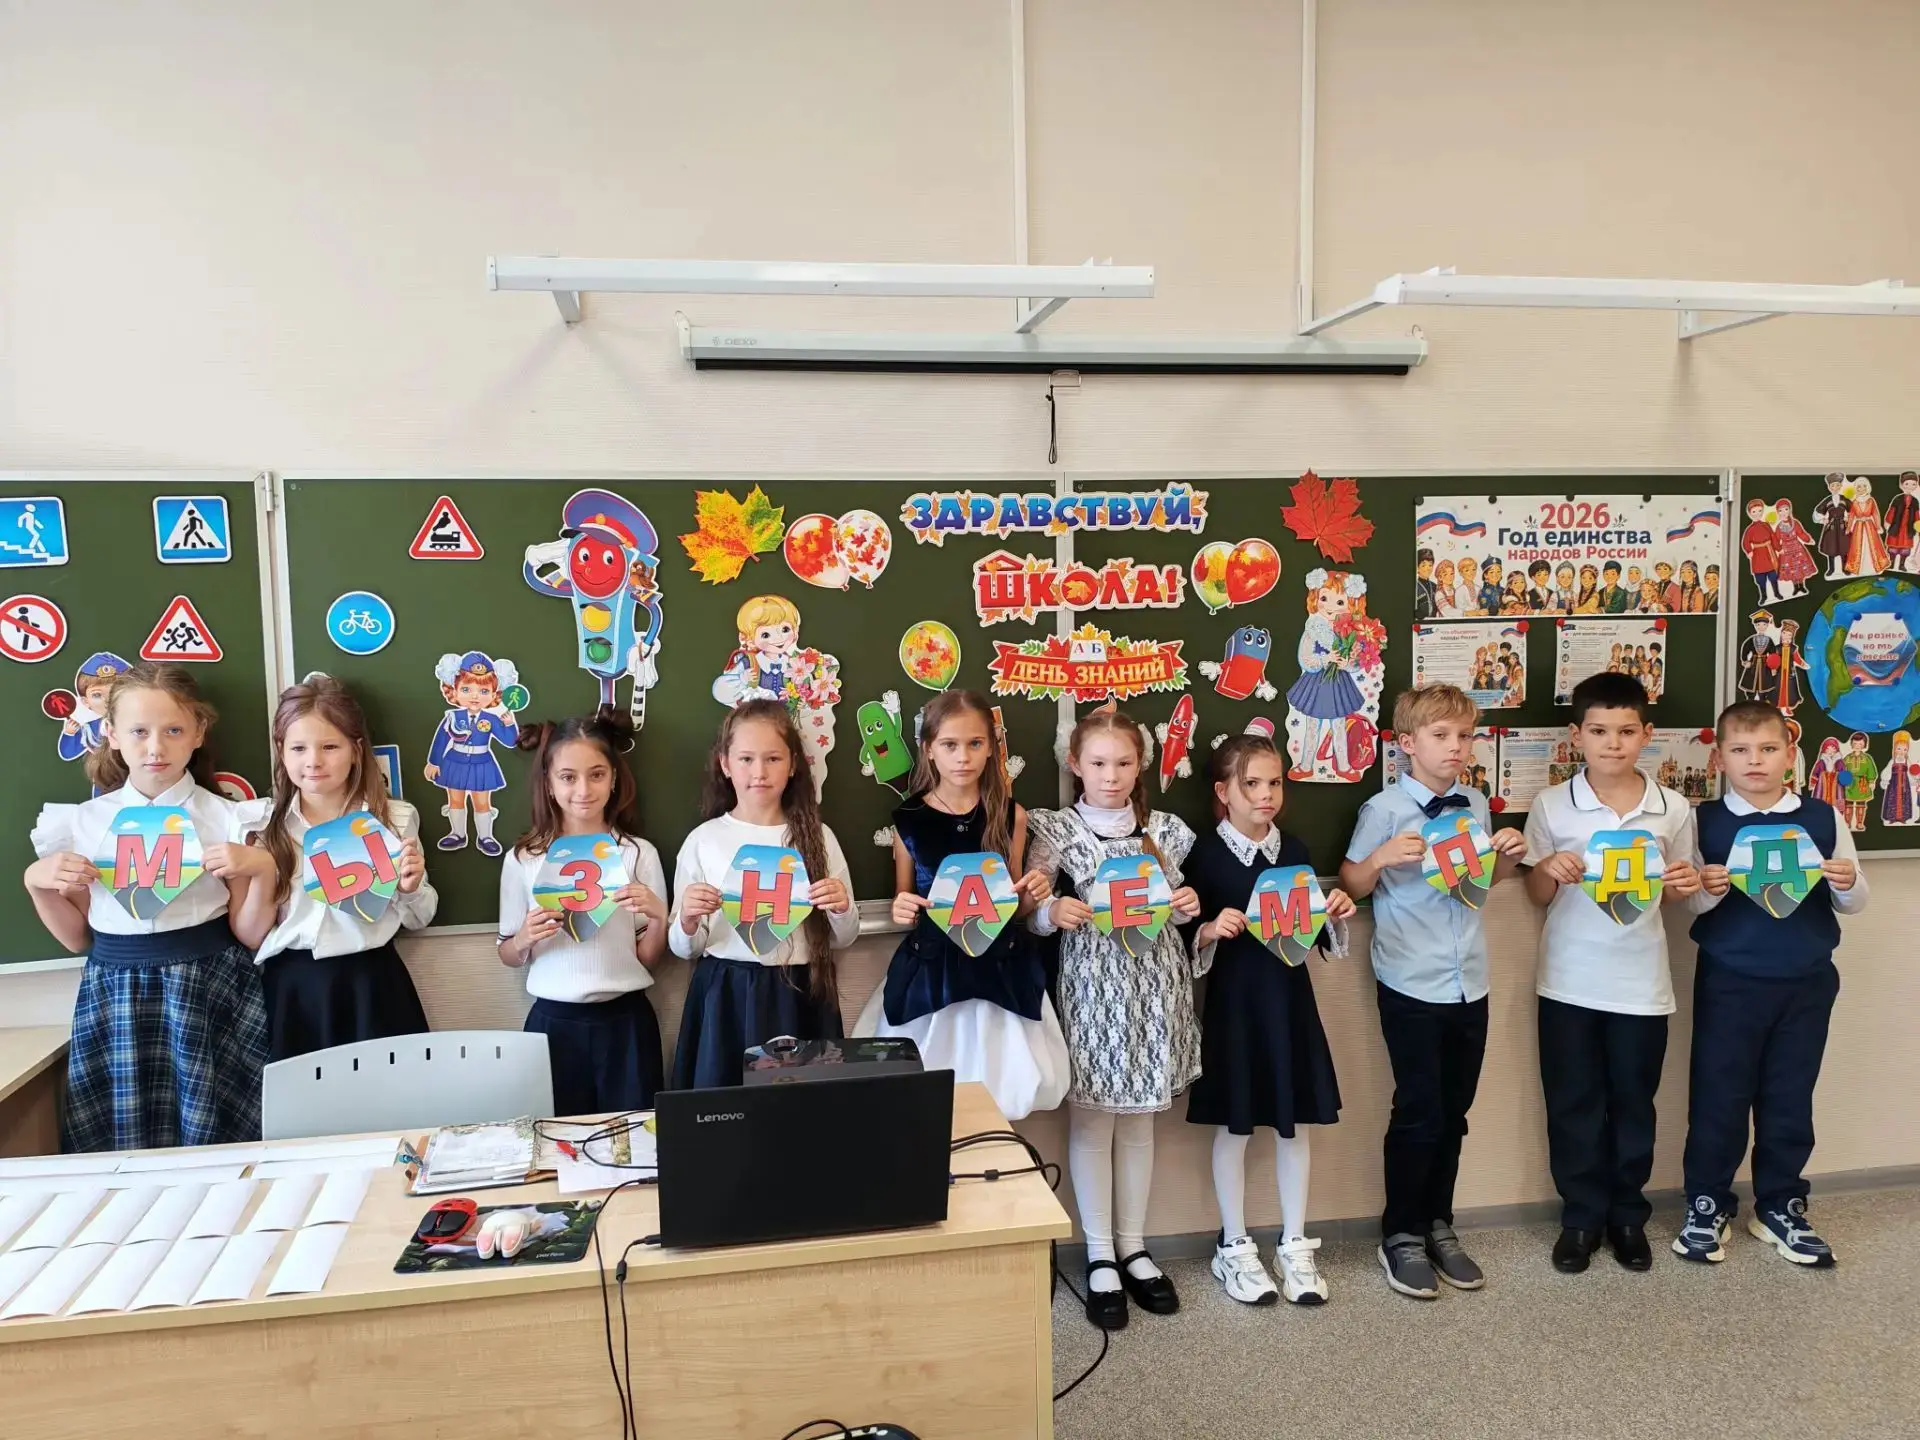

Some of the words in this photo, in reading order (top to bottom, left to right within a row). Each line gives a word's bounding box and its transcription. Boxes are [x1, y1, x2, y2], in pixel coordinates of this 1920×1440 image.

[909, 487, 1201, 531] ЗДРАВСТВУЙ,
[1540, 502, 1611, 529] 2026
[1498, 528, 1538, 547] Год
[1544, 529, 1652, 547] единства
[1508, 548, 1581, 562] народов
[1586, 546, 1648, 559] России
[977, 565, 1178, 609] ШКОЛА!
[1009, 660, 1069, 685] ДЕНЬ
[1074, 656, 1167, 685] ЗНАНИЙ
[1074, 642, 1085, 654] А
[1091, 642, 1102, 654] Б
[113, 834, 184, 889] М
[309, 831, 398, 905] Ы
[1432, 830, 1483, 889] П
[1594, 847, 1651, 902] Д
[1746, 839, 1809, 894] Д
[739, 870, 793, 925] Н
[948, 874, 1001, 926] А
[1109, 876, 1153, 929] Е
[1258, 887, 1313, 940] М
[696, 1112, 745, 1123] Lenovo
